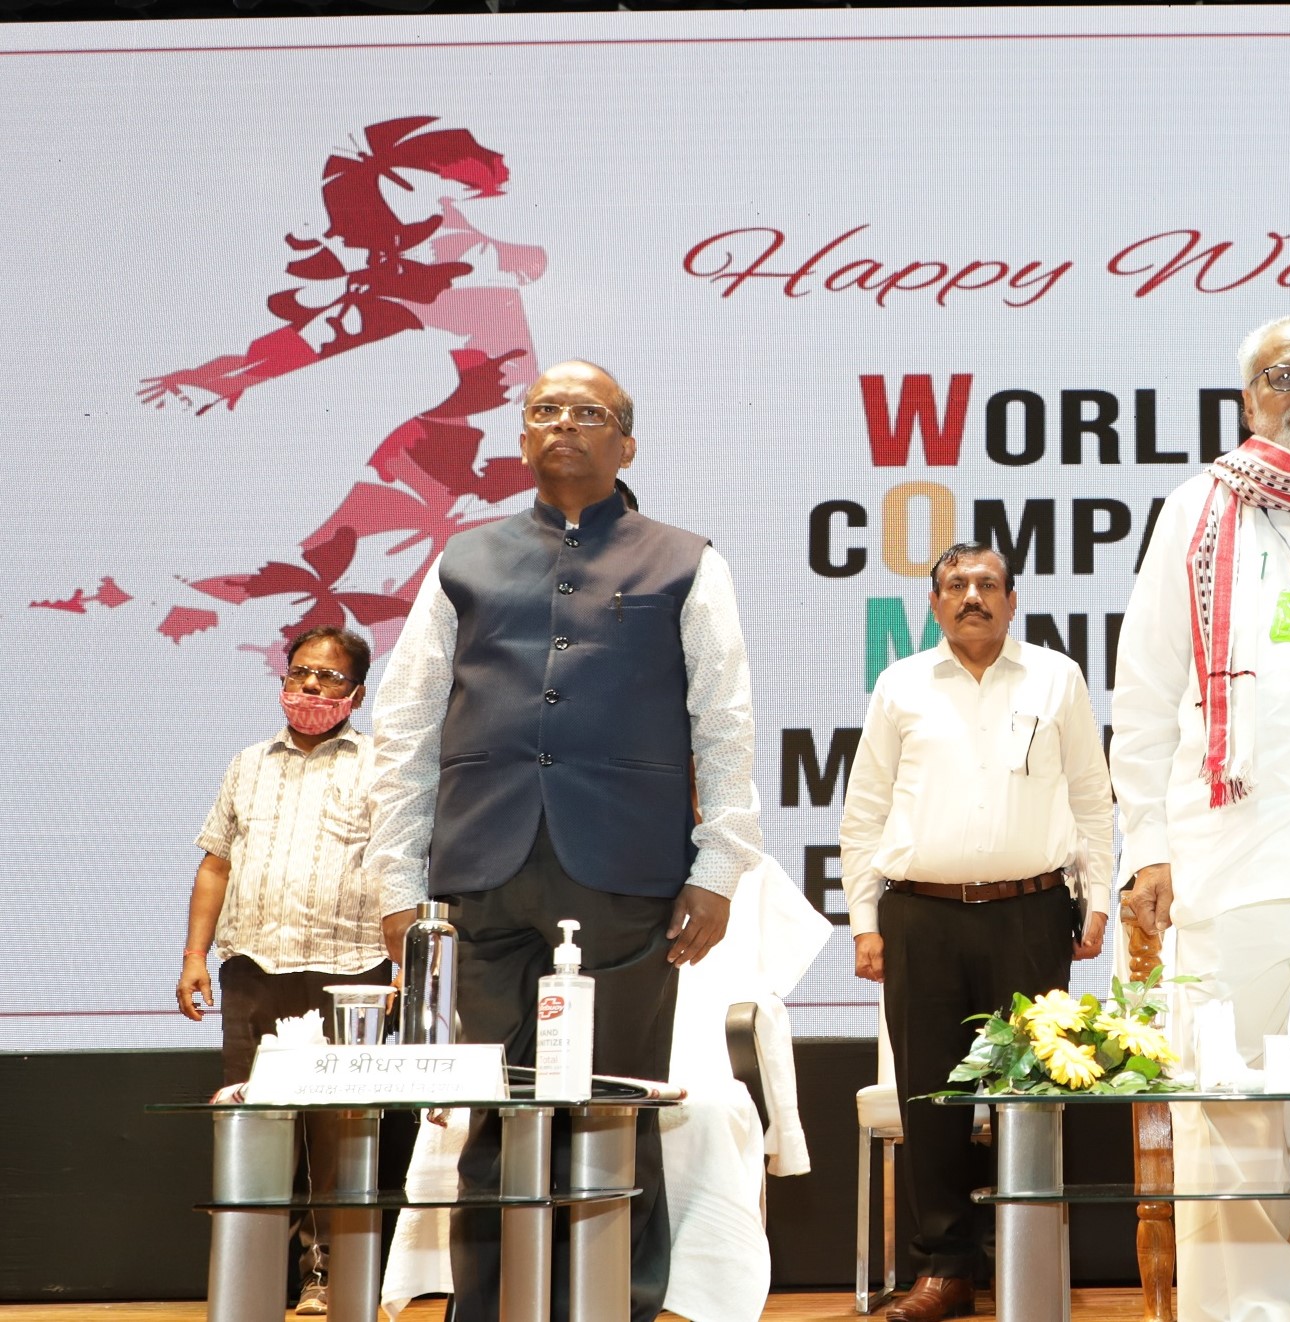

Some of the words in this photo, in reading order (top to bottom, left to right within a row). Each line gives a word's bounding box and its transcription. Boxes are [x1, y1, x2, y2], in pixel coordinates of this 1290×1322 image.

[683, 224, 1073, 307] Happy
[859, 373, 1250, 467] WORLD
[313, 1052, 339, 1074] श्री
[347, 1052, 406, 1074] श्रीधर
[415, 1058, 456, 1073] पात्र
